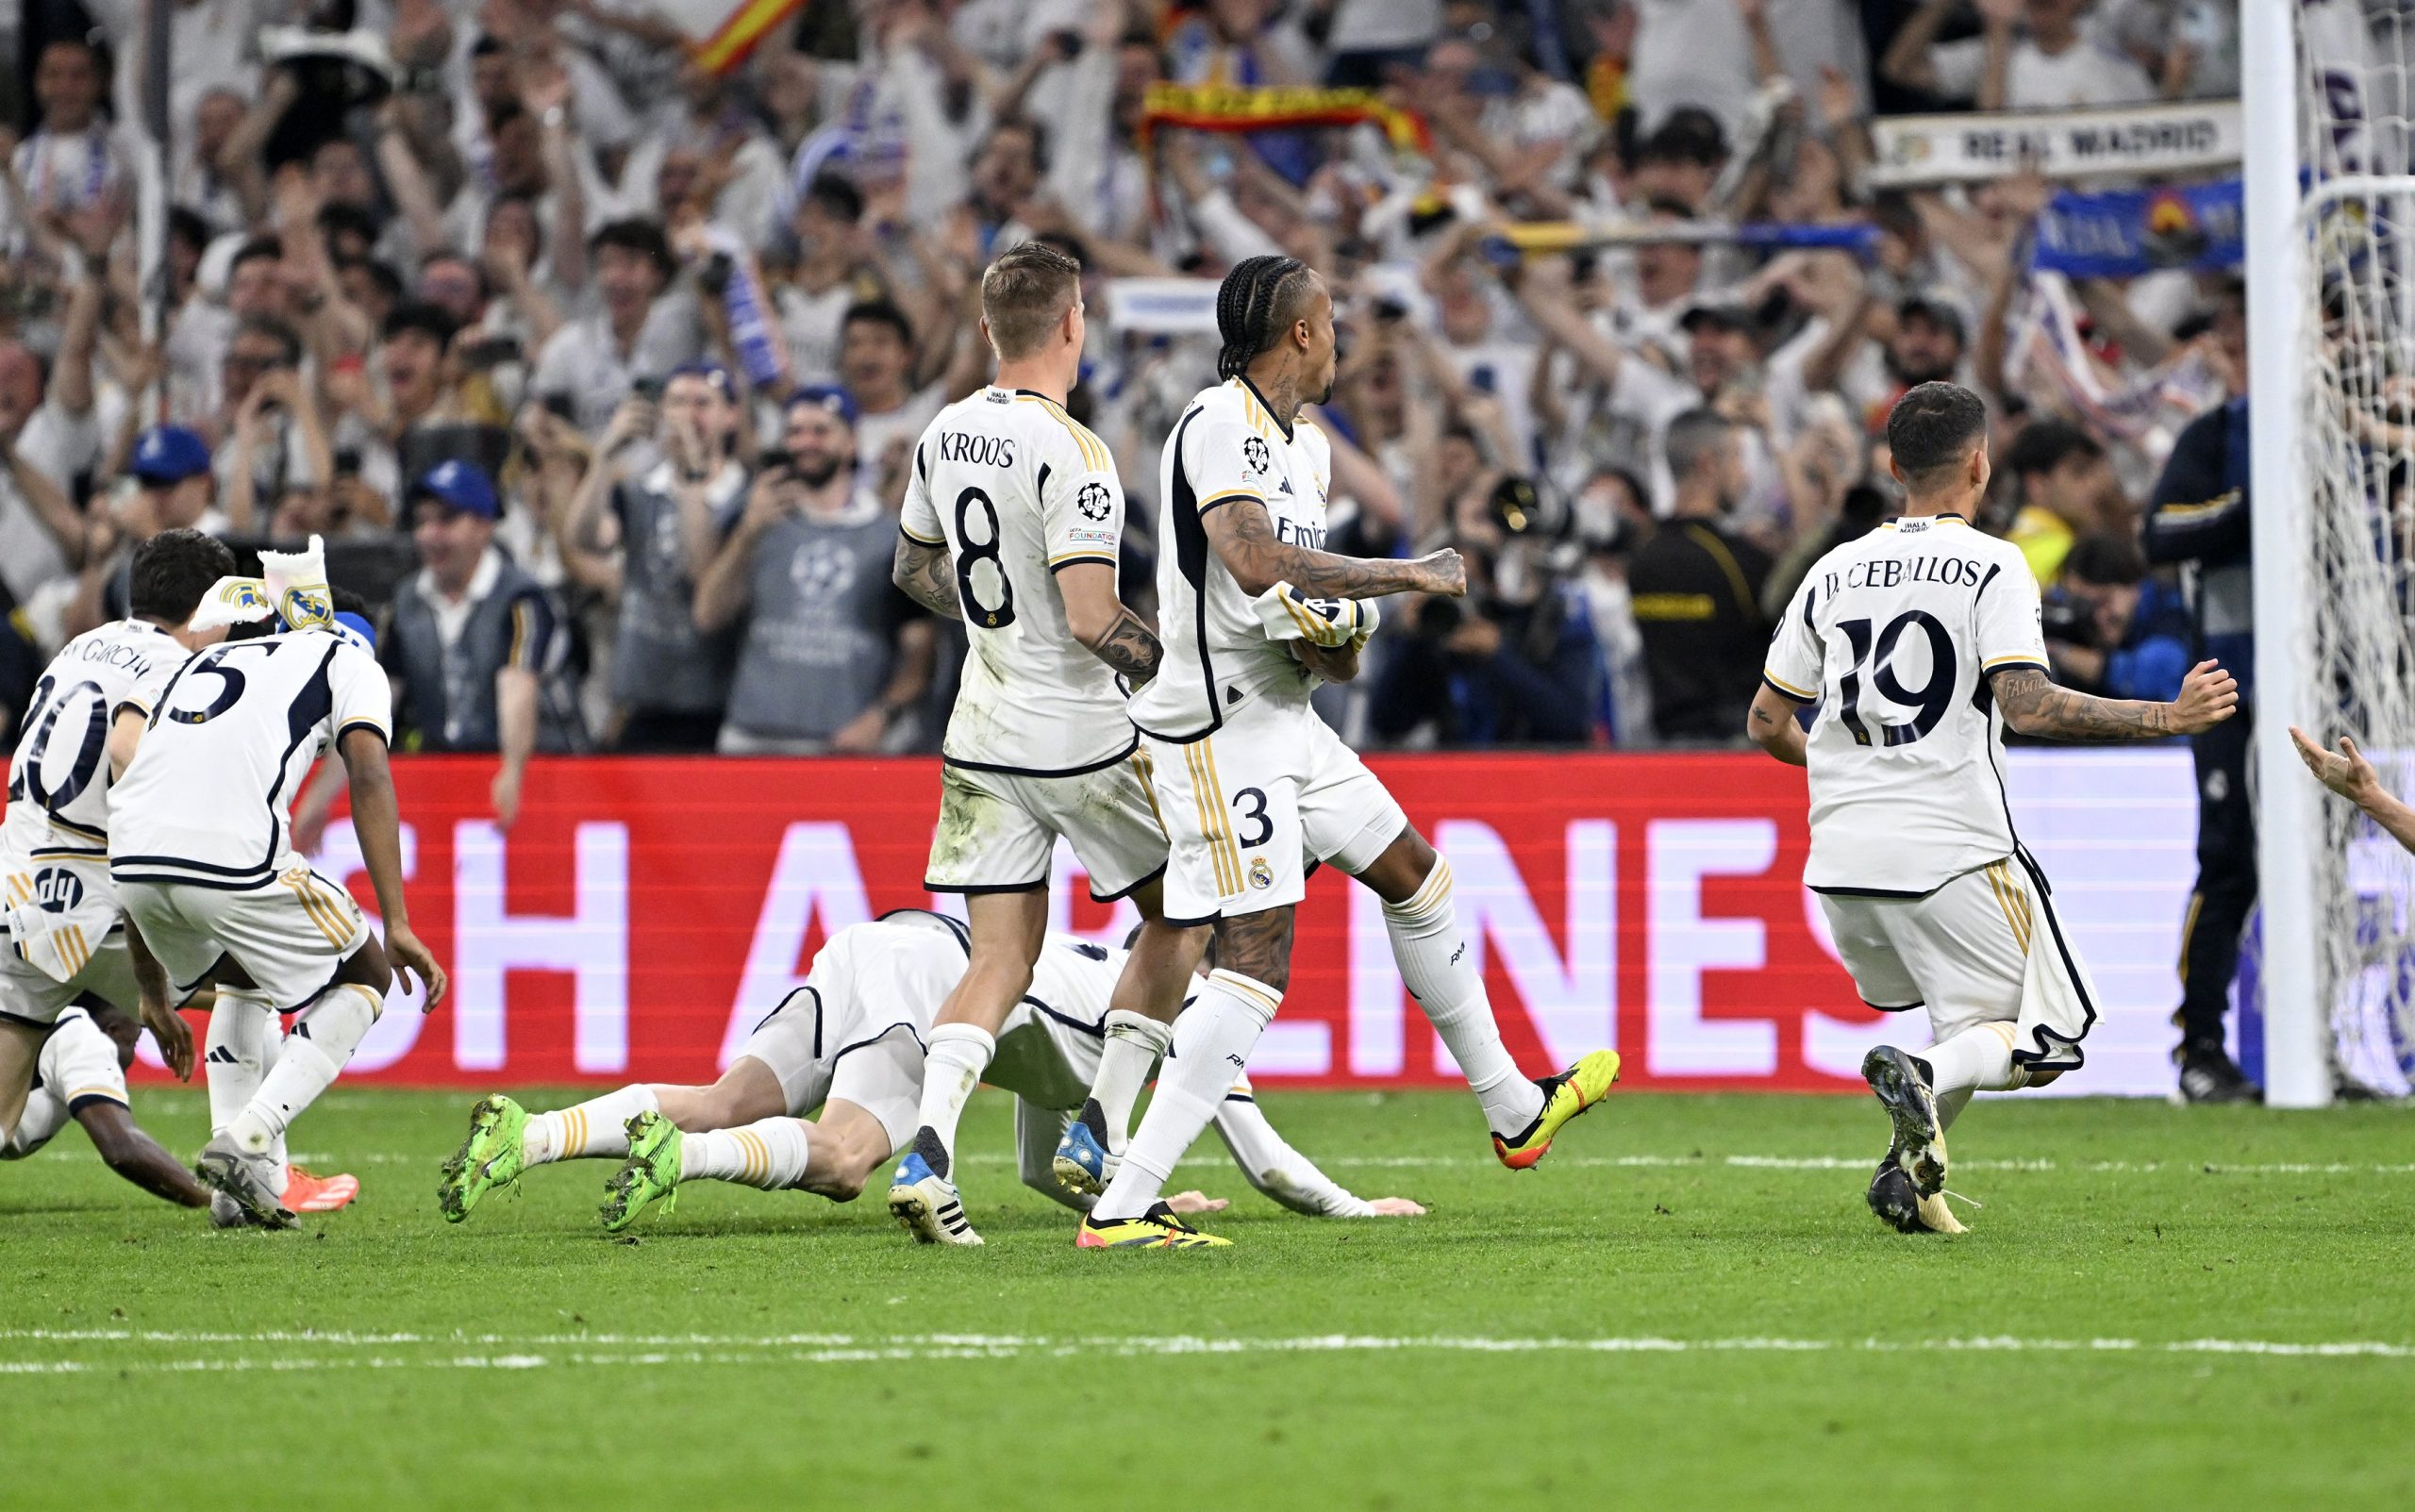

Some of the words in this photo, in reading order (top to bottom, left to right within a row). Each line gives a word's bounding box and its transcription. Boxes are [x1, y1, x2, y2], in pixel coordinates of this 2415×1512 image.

[1962, 128, 2052, 159] REAL
[2069, 117, 2220, 158] MADRID
[941, 431, 1016, 469] KROOS
[955, 486, 1017, 629] 8
[1824, 572, 1840, 602] D.
[1847, 557, 1981, 589] CEBALLOS
[1835, 609, 1957, 748] 19
[8, 674, 108, 813] 20
[1232, 787, 1274, 850] 3
